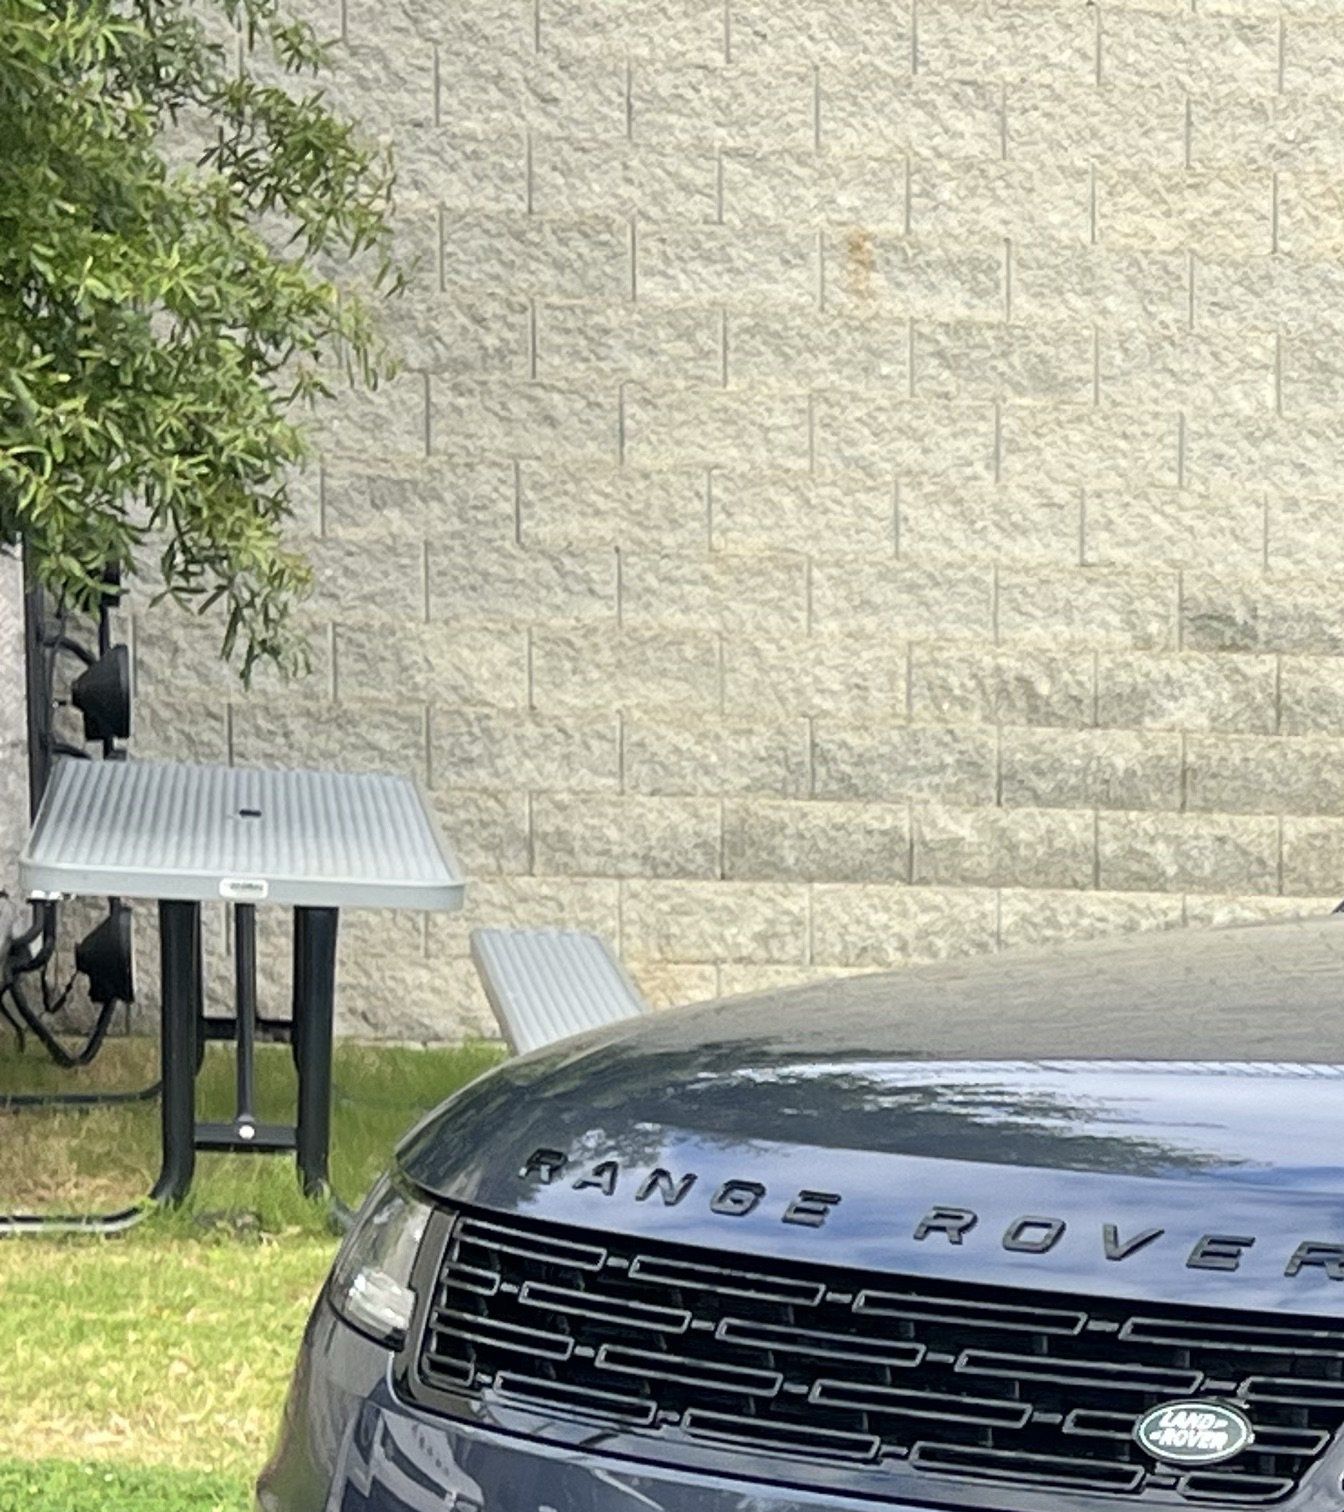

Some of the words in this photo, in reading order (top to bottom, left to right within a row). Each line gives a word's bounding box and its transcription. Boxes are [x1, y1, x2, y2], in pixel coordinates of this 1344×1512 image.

[517, 1146, 842, 1228] RANGE
[1158, 1409, 1218, 1430] LAND
[1158, 1428, 1229, 1450] ROVER
